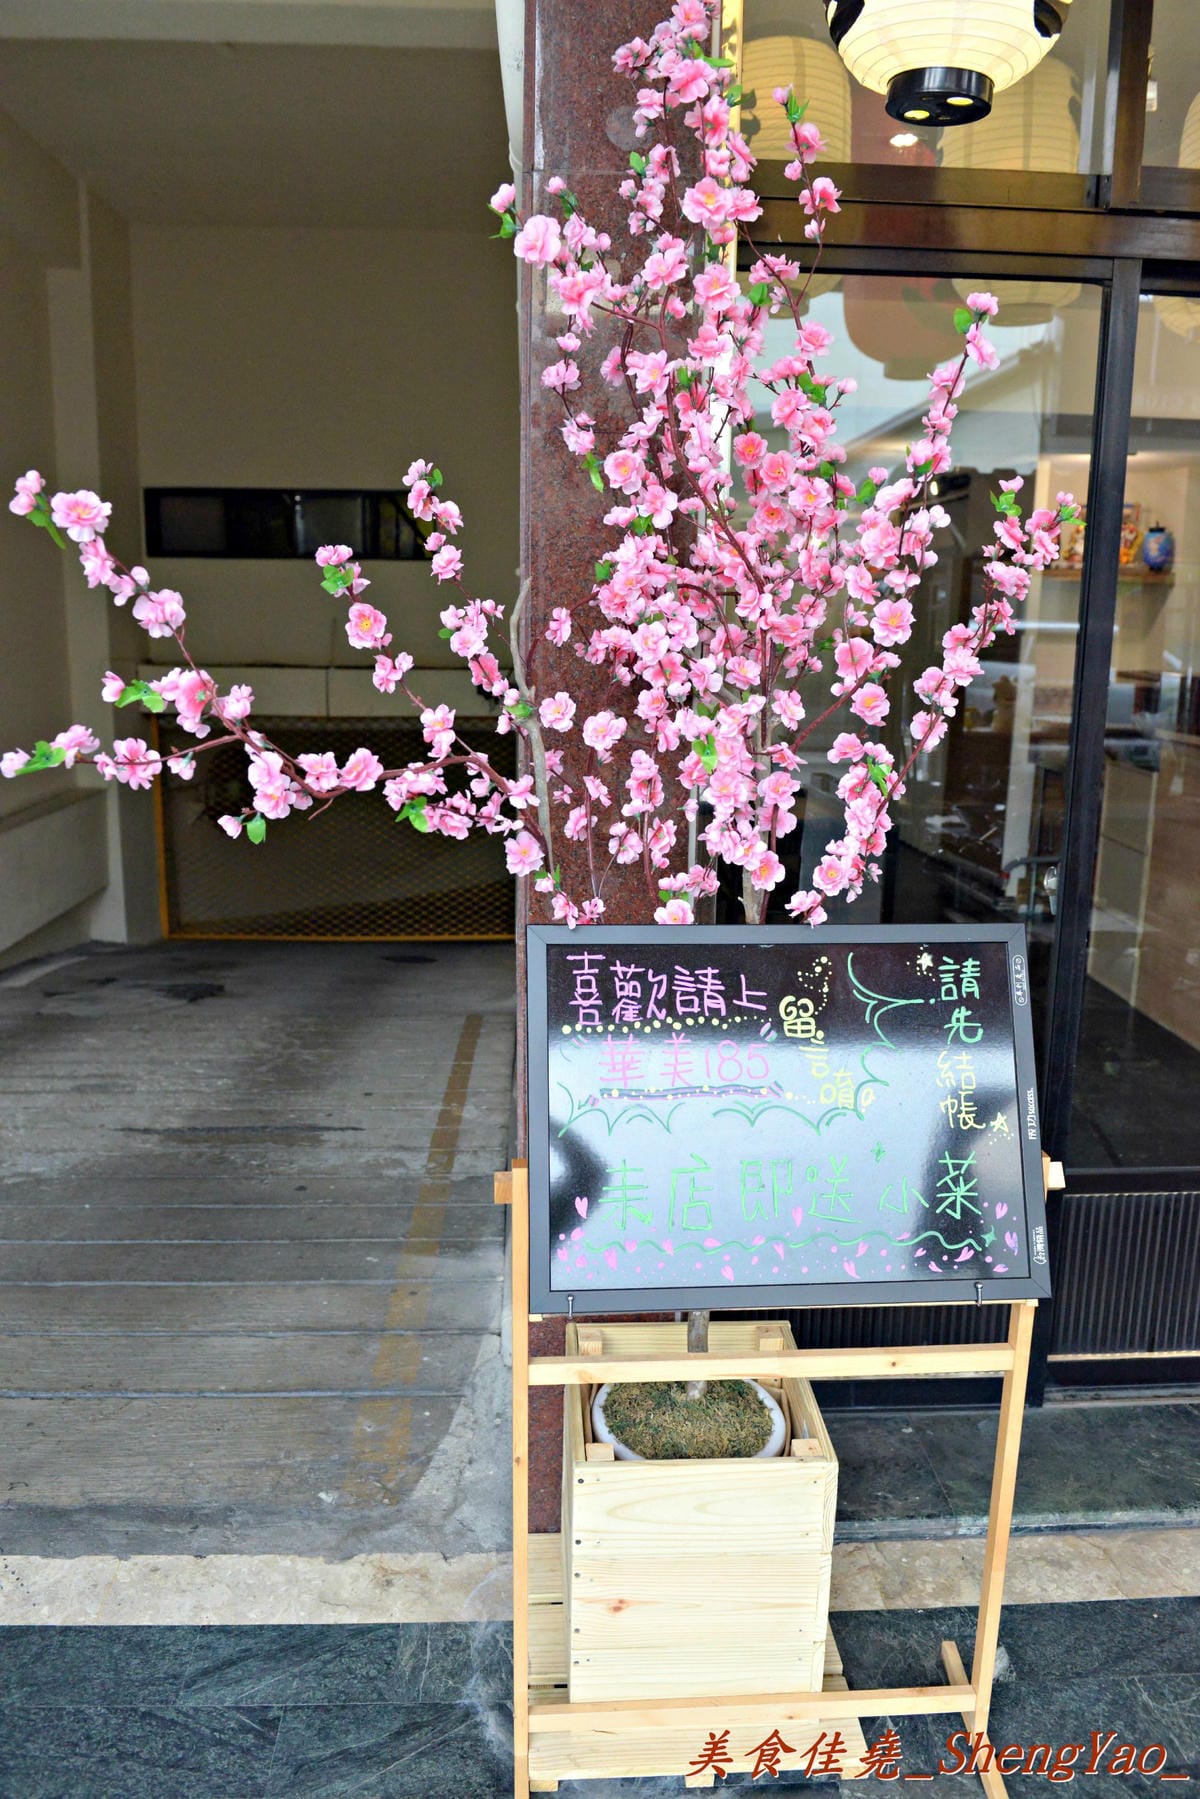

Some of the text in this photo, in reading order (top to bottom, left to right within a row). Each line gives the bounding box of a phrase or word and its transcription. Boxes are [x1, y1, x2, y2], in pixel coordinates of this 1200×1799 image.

[566, 951, 768, 1026] 喜歡請上
[936, 955, 986, 1130] 請先結帳
